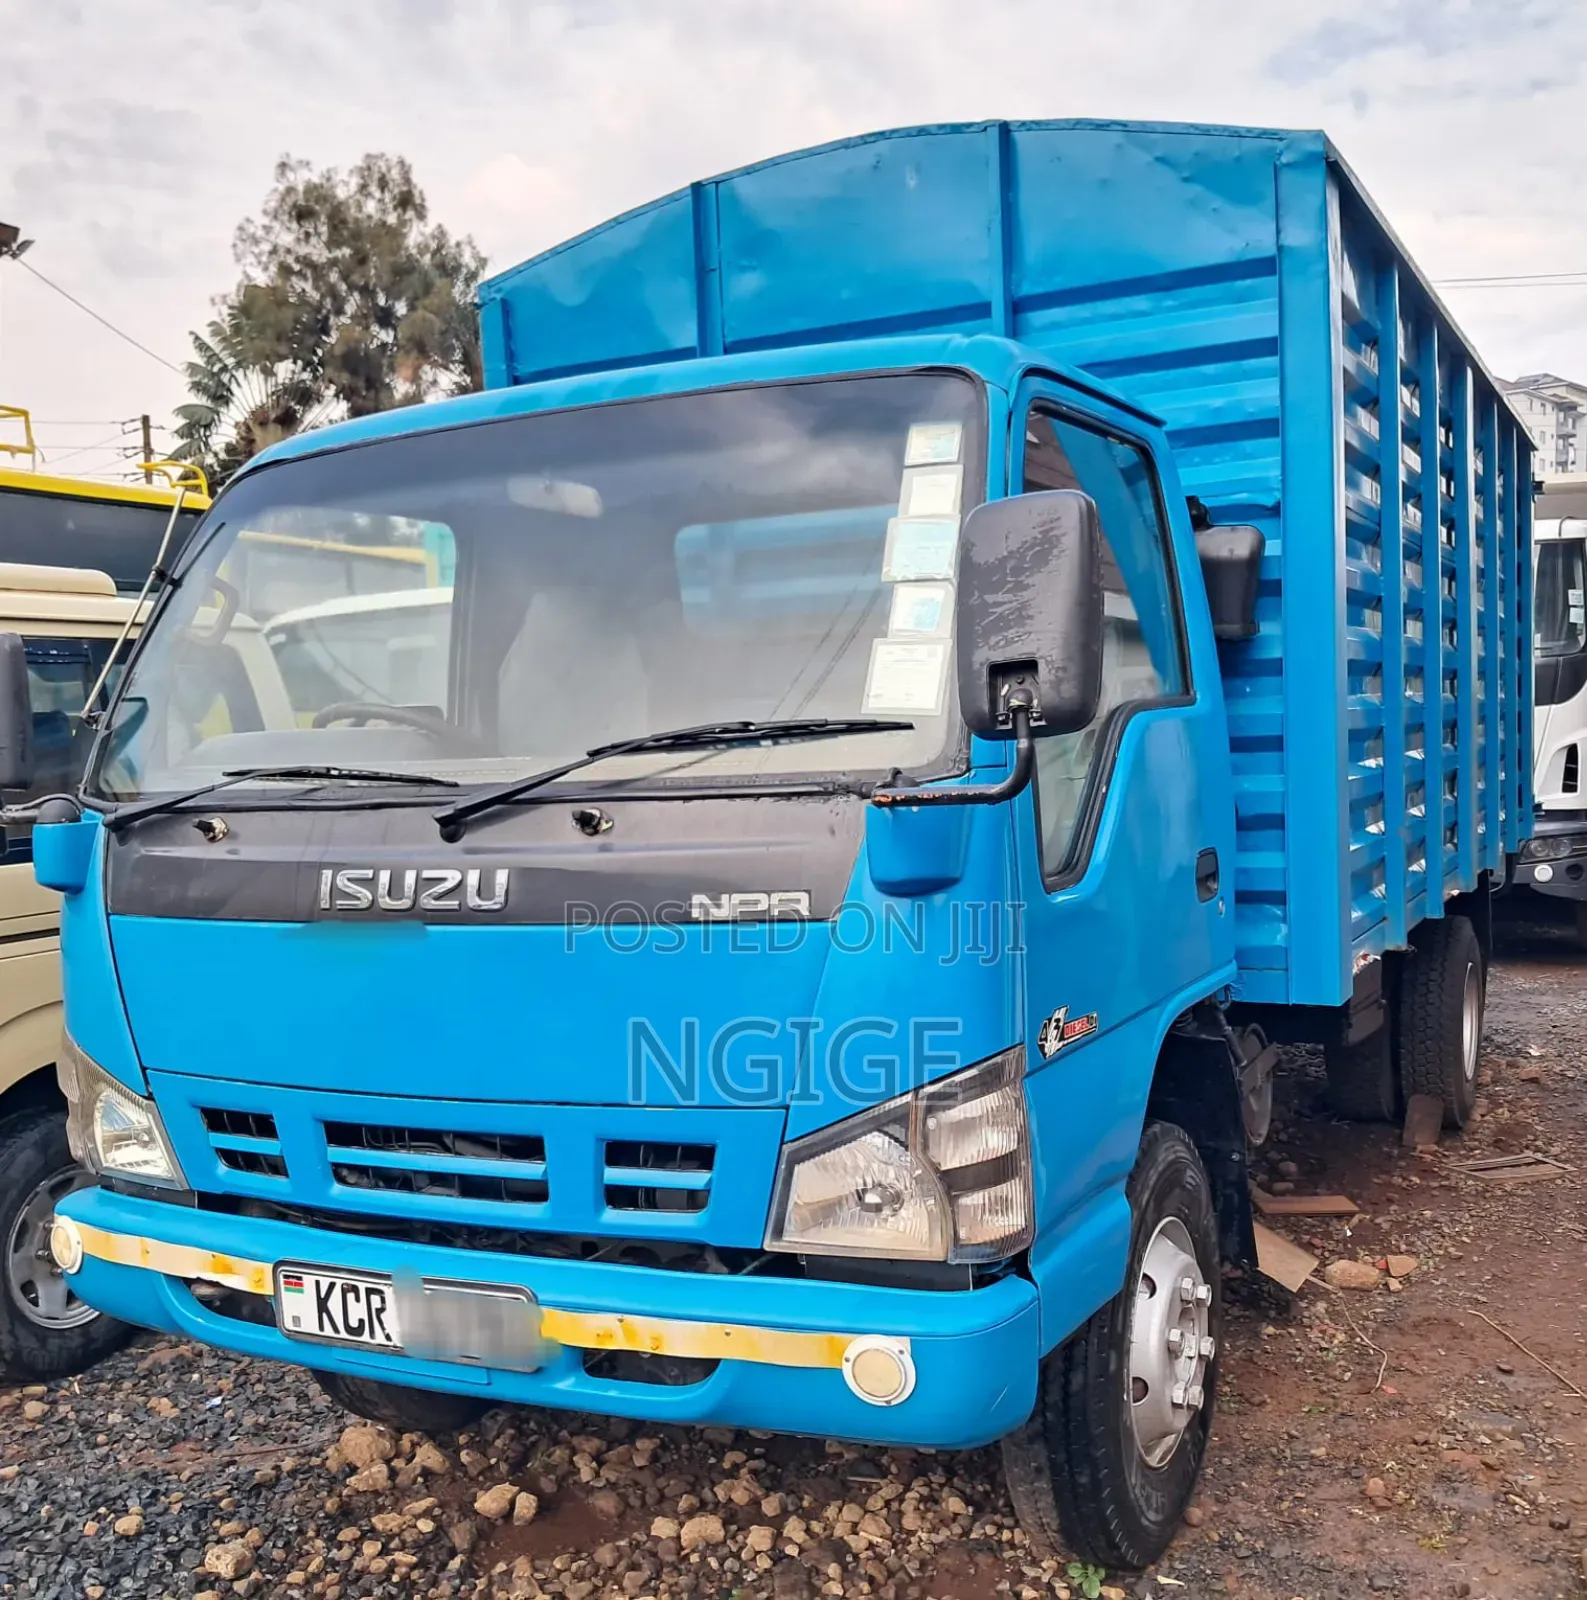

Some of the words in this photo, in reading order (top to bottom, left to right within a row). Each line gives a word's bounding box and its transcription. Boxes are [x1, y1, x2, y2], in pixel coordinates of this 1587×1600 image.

[319, 868, 509, 911] ISUZU
[691, 891, 811, 918] NPR
[315, 1279, 392, 1342] KCR
